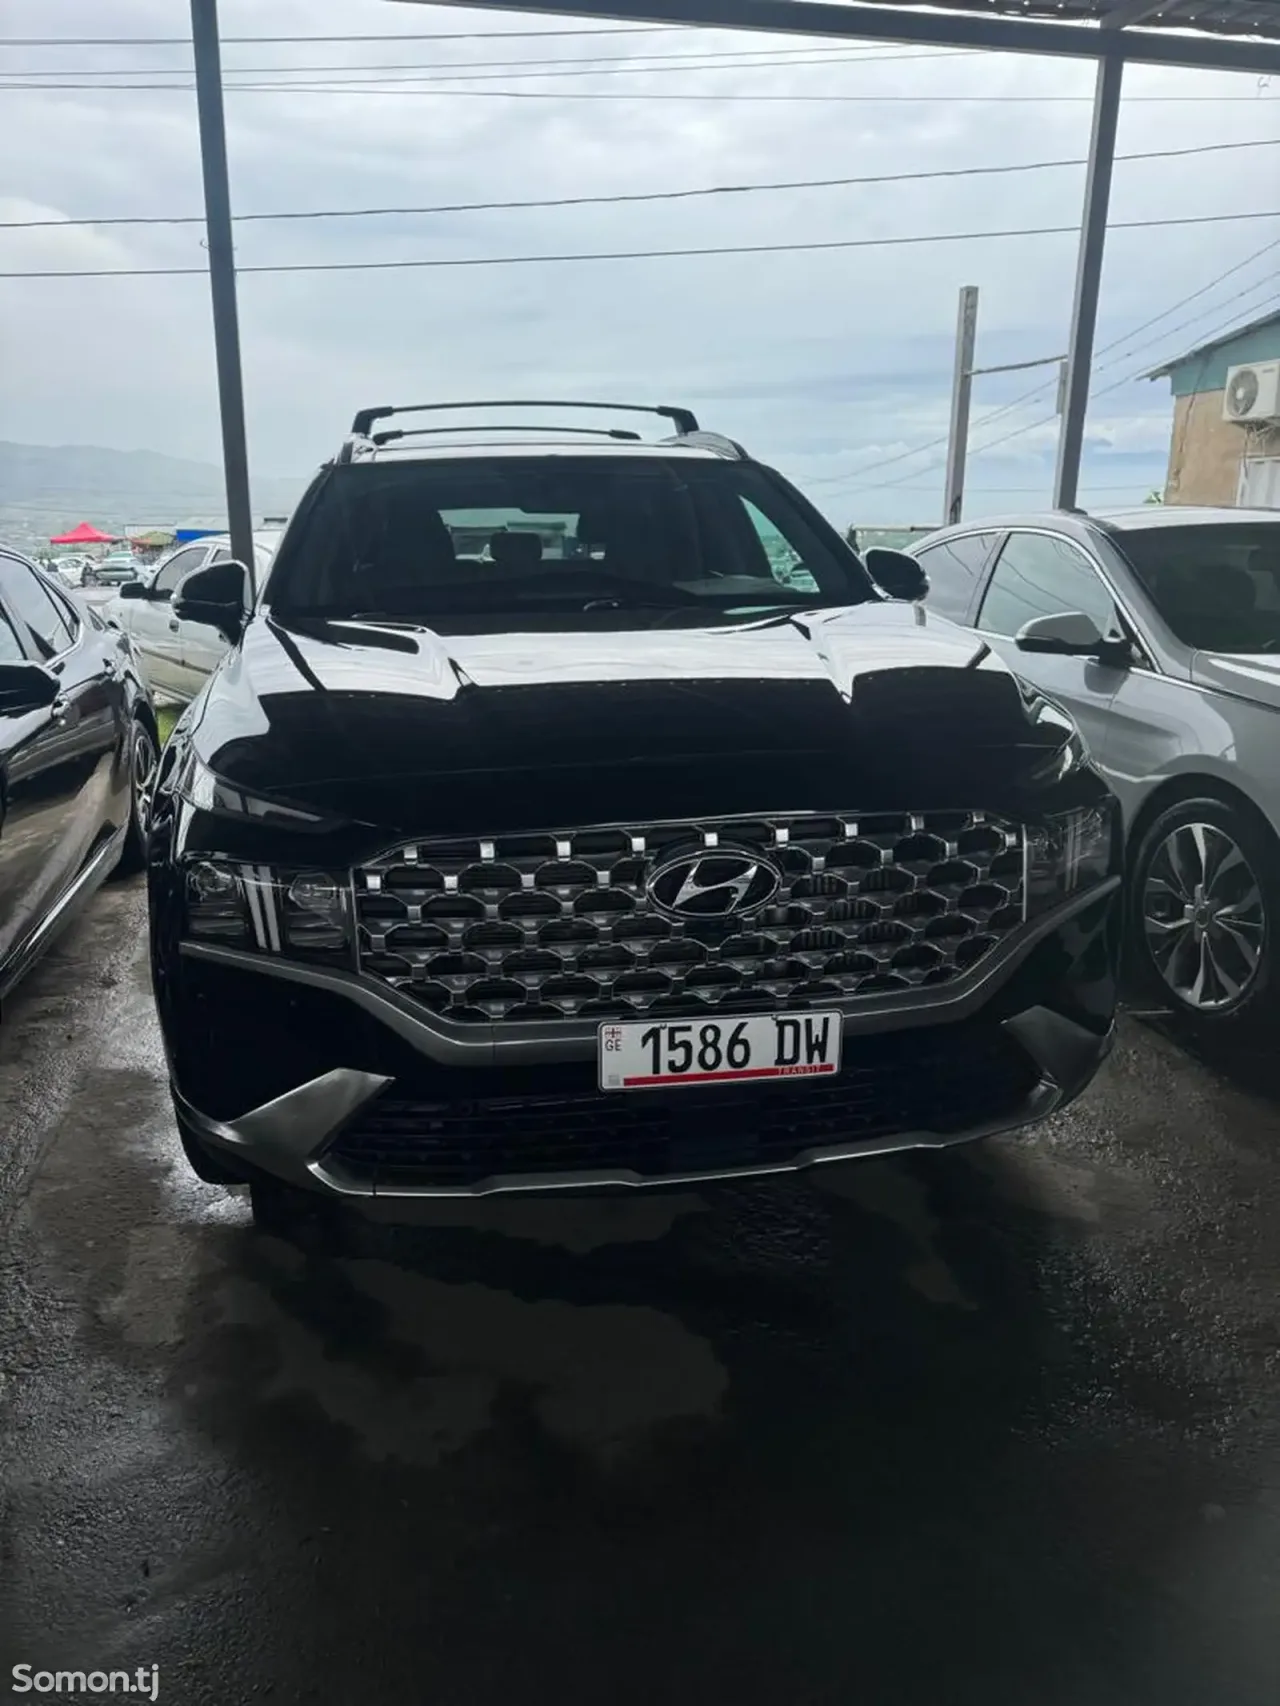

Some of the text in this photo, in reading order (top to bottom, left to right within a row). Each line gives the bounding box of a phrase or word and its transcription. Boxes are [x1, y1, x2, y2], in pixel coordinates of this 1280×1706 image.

[605, 1039, 622, 1051] GE
[641, 1017, 829, 1075] 1586 DW
[778, 1065, 820, 1076] TRANSIT
